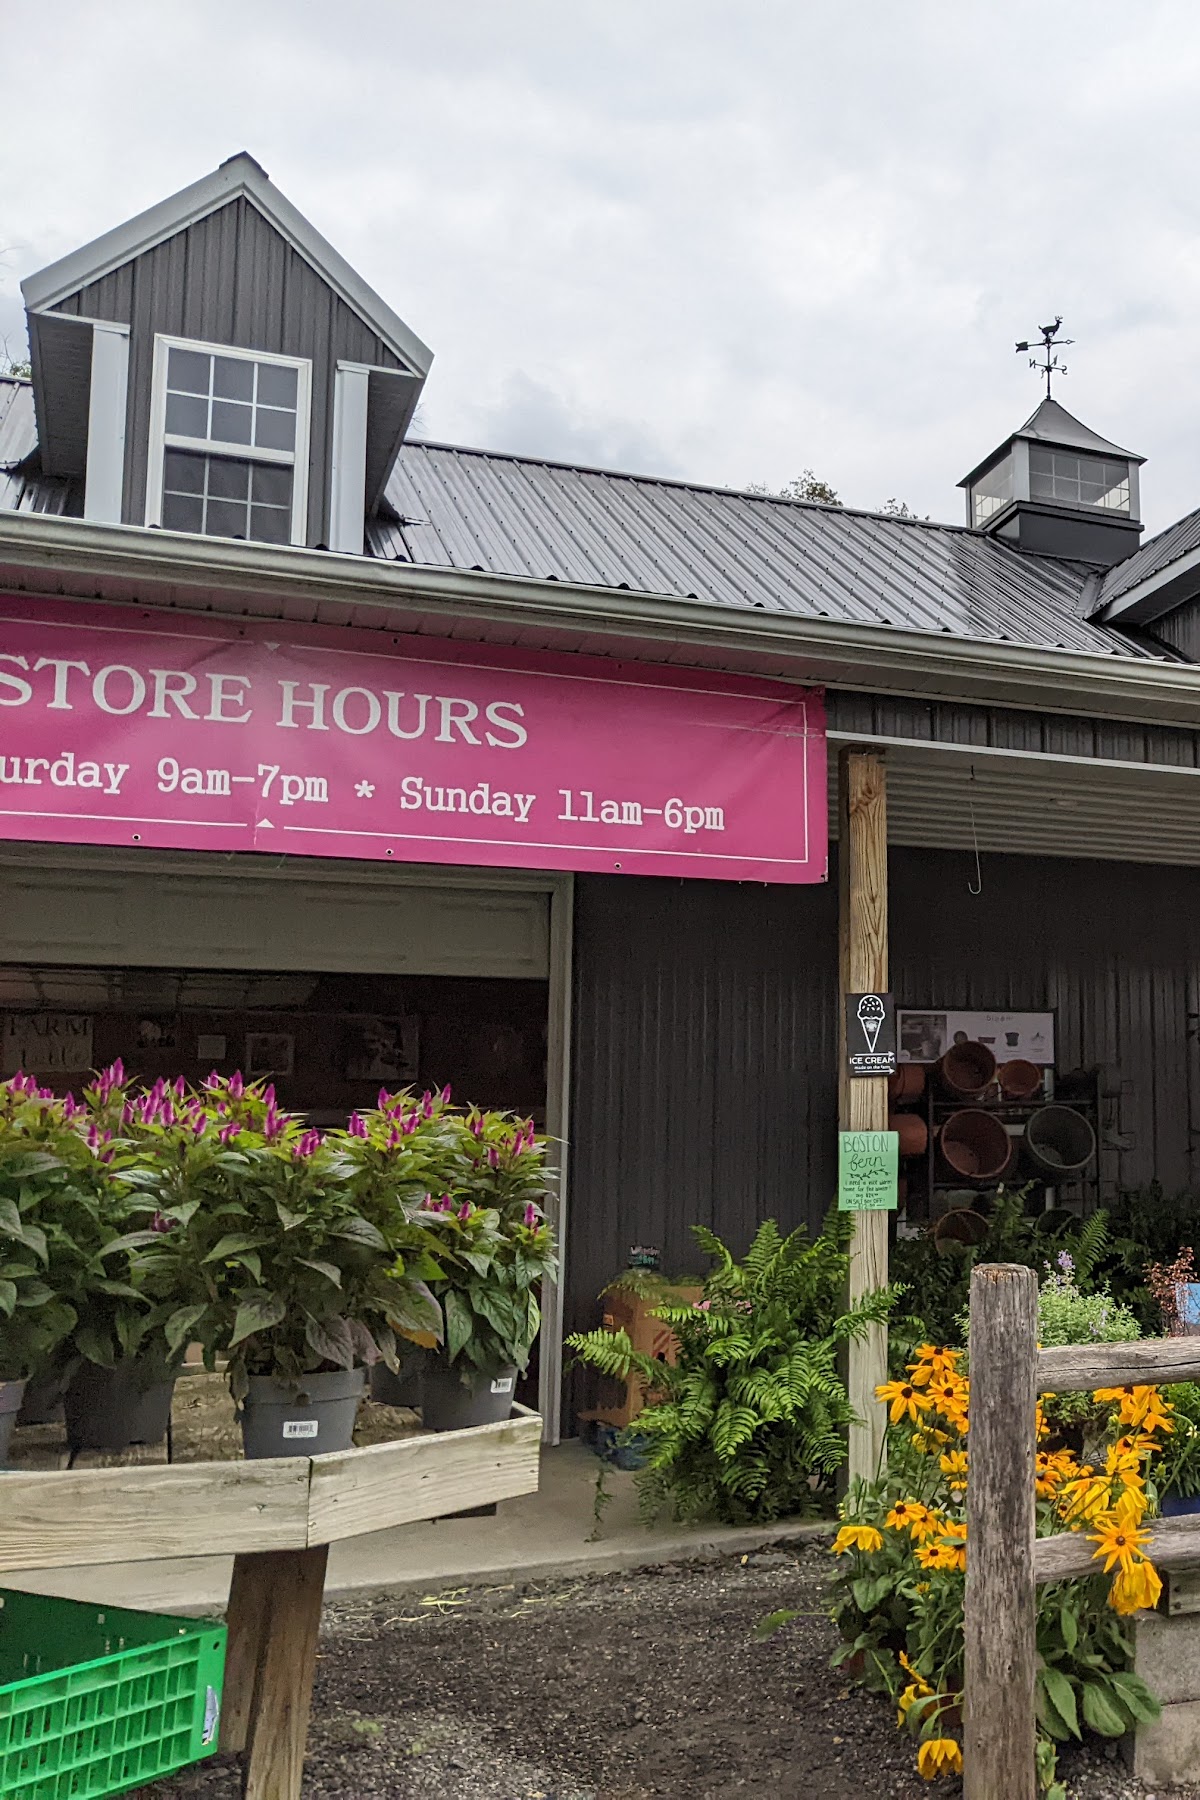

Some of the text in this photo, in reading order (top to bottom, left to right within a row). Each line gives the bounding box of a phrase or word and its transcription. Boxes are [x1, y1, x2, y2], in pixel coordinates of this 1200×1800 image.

[0, 653, 528, 749] STORE HOURS
[157, 757, 329, 805] 9am-7pm
[400, 776, 537, 823] Sunday
[558, 789, 725, 834] 11am-6pm
[850, 1056, 895, 1064] ICE CREAM
[843, 1134, 889, 1153] BOSTON
[848, 1153, 886, 1171] fern
